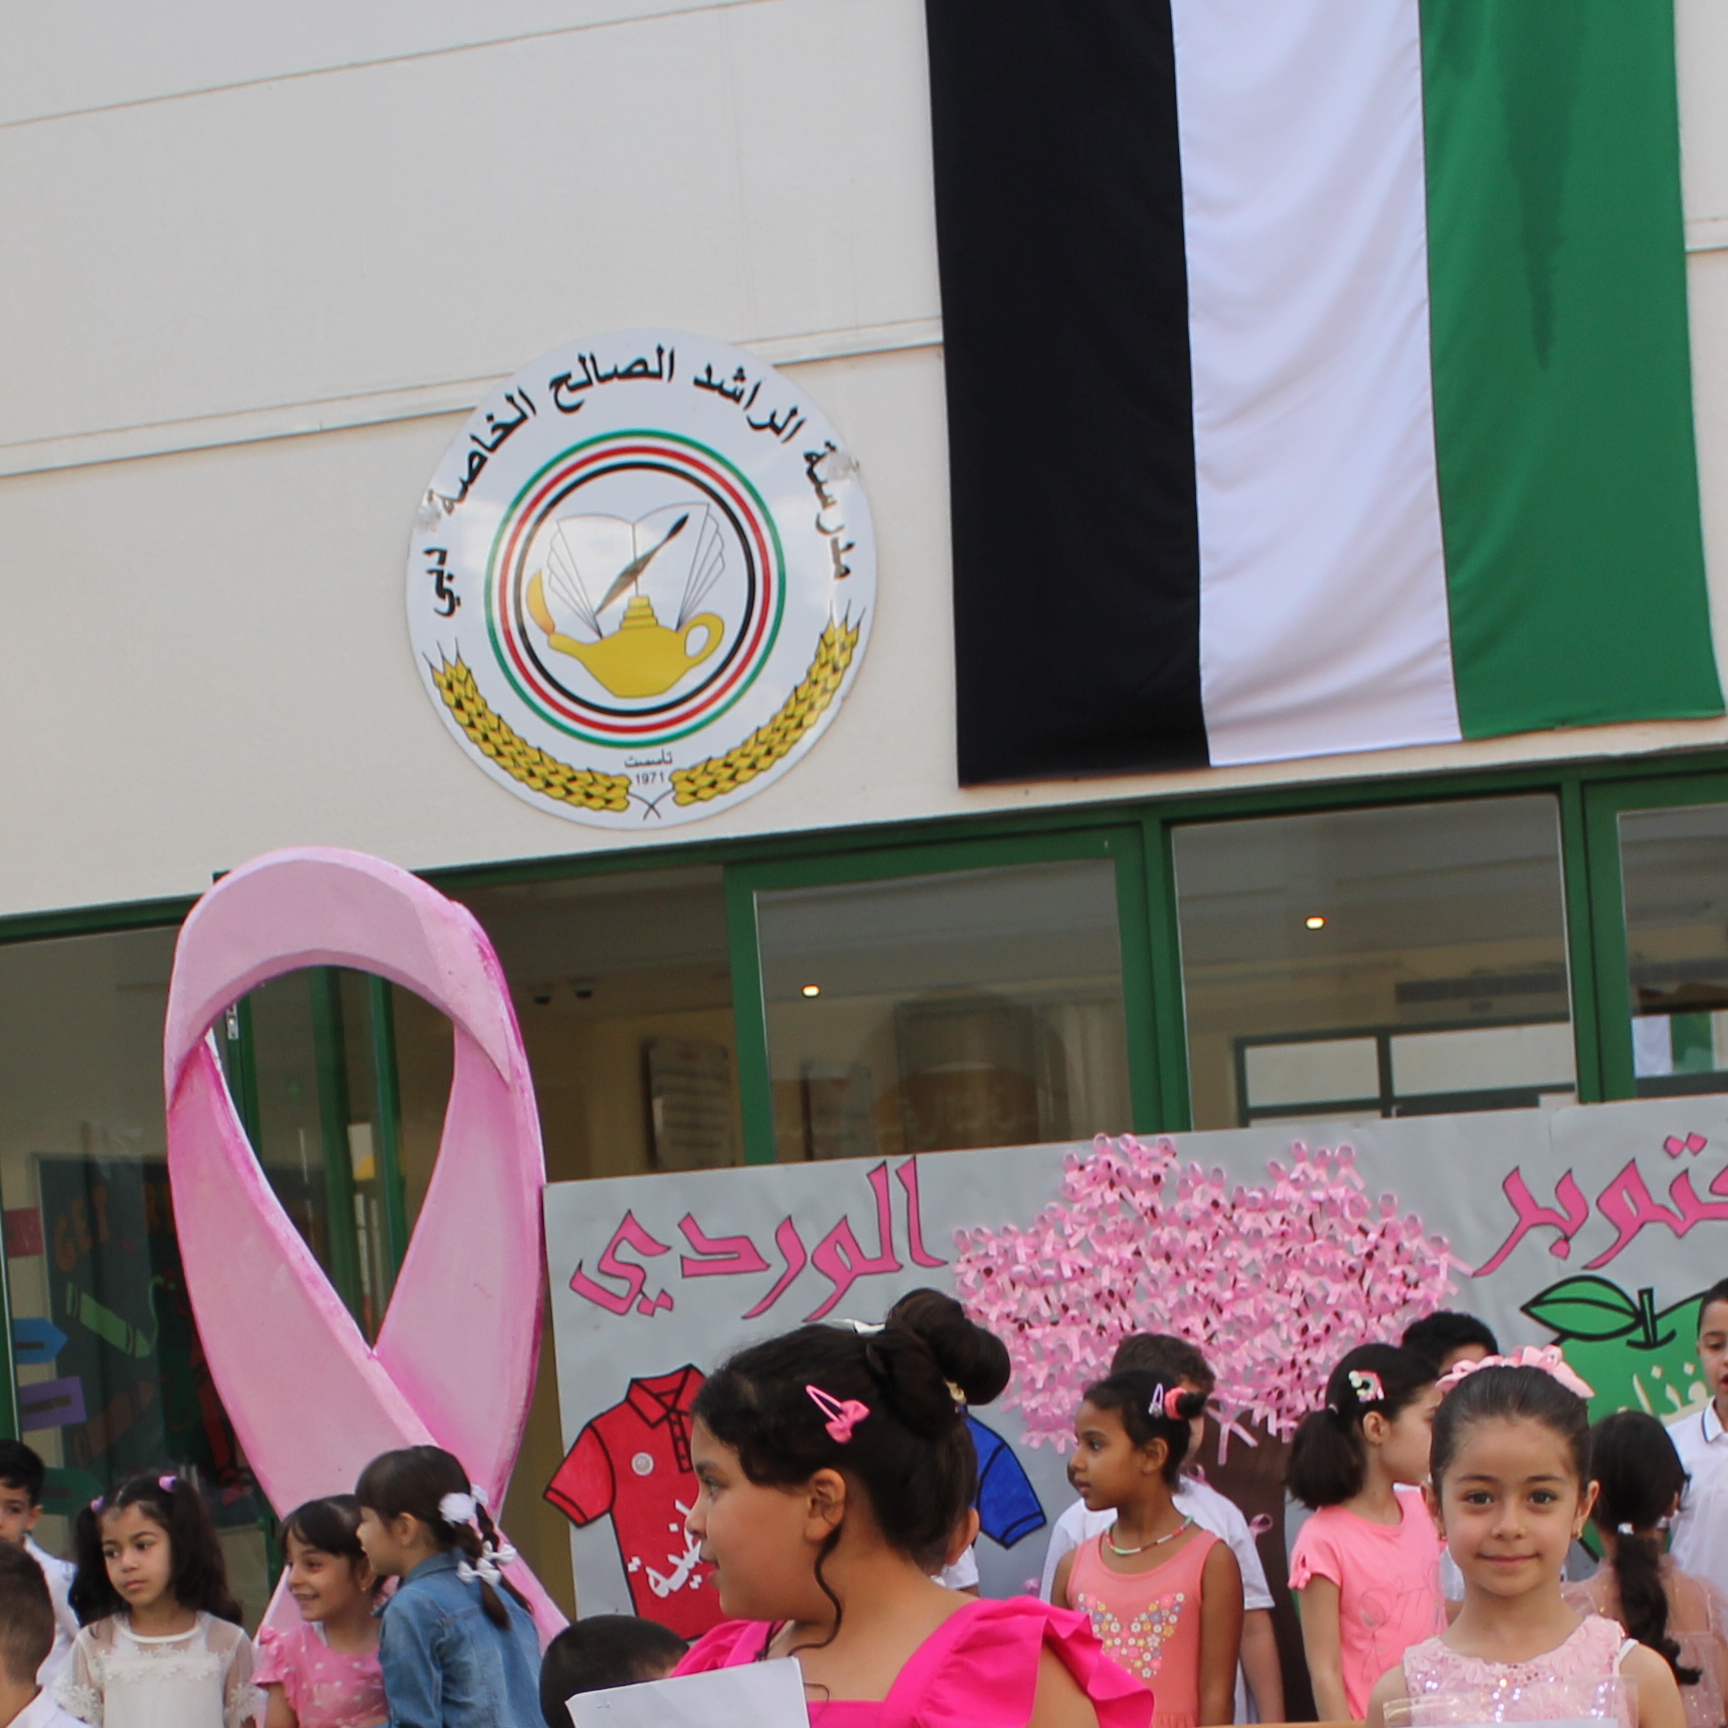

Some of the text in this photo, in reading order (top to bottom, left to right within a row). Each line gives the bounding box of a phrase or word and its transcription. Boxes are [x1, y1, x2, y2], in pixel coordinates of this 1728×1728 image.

[548, 344, 676, 414] الصالح
[693, 362, 807, 444] الراشد
[802, 439, 856, 580] مدرسة
[421, 546, 462, 618] دبي
[636, 770, 665, 786] 1971
[568, 1154, 949, 1322] الوردي
